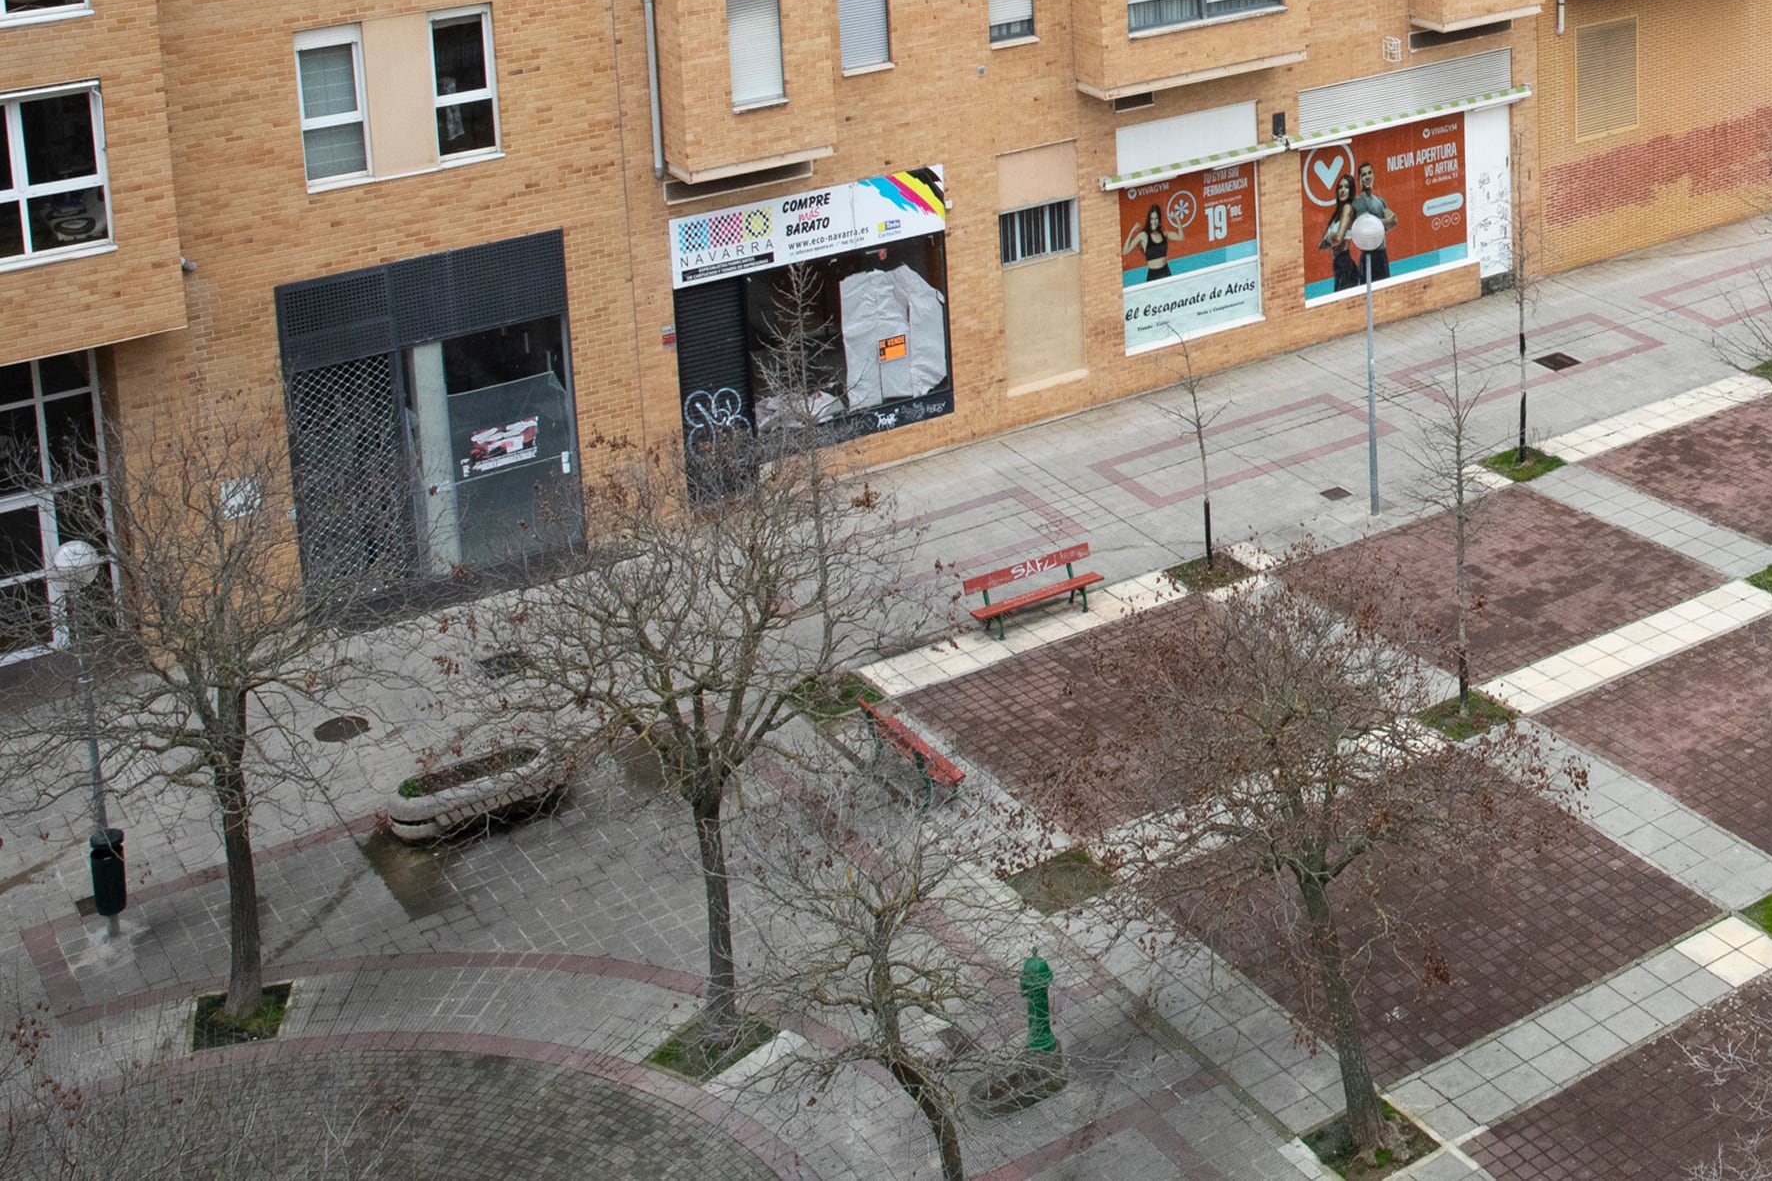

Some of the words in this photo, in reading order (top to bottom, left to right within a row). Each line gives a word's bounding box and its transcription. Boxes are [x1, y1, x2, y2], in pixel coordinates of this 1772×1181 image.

[1430, 123, 1458, 136] VIVAGYM
[1386, 151, 1415, 173] NUEVA
[1415, 142, 1458, 166] APERTURA
[1435, 158, 1459, 175] ARTIKA
[1212, 169, 1227, 182] GYM
[1137, 182, 1170, 196] VIVAGYM
[1203, 177, 1248, 197] PERMANENCIA
[781, 192, 831, 214] COMPRE
[797, 206, 821, 221] más
[785, 217, 830, 237] BARATO
[788, 227, 869, 250] www.eco-navarra.es
[680, 238, 774, 268] NAVARRA
[1125, 306, 1140, 322] El
[1142, 291, 1206, 317] Escaparate
[1209, 287, 1222, 301] de
[1224, 278, 1256, 297] Atrás
